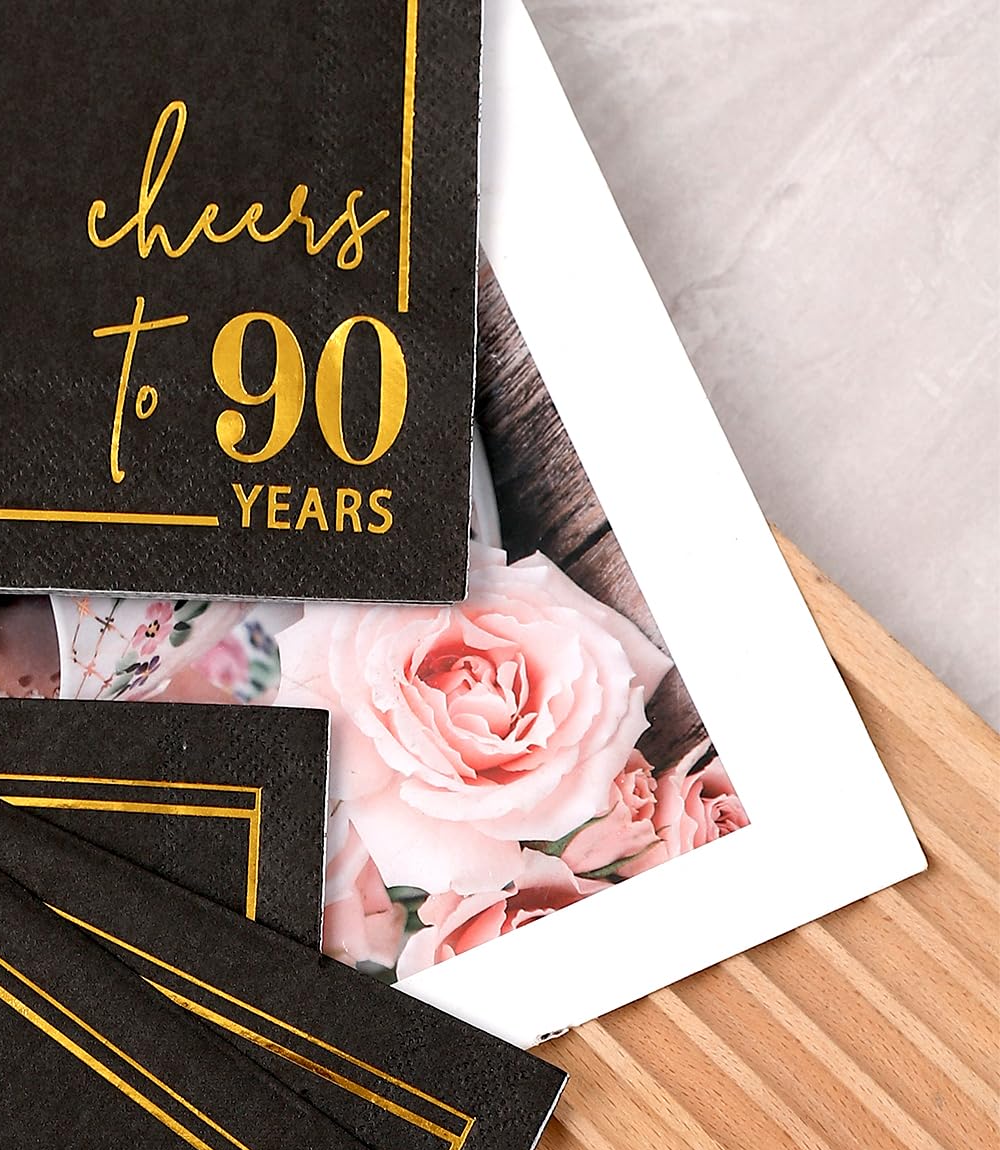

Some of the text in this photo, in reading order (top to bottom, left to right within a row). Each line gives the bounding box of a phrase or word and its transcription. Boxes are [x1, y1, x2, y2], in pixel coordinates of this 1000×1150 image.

[87, 100, 390, 270] cheers
[92, 295, 408, 484] to 90
[231, 482, 394, 534] YEARS
